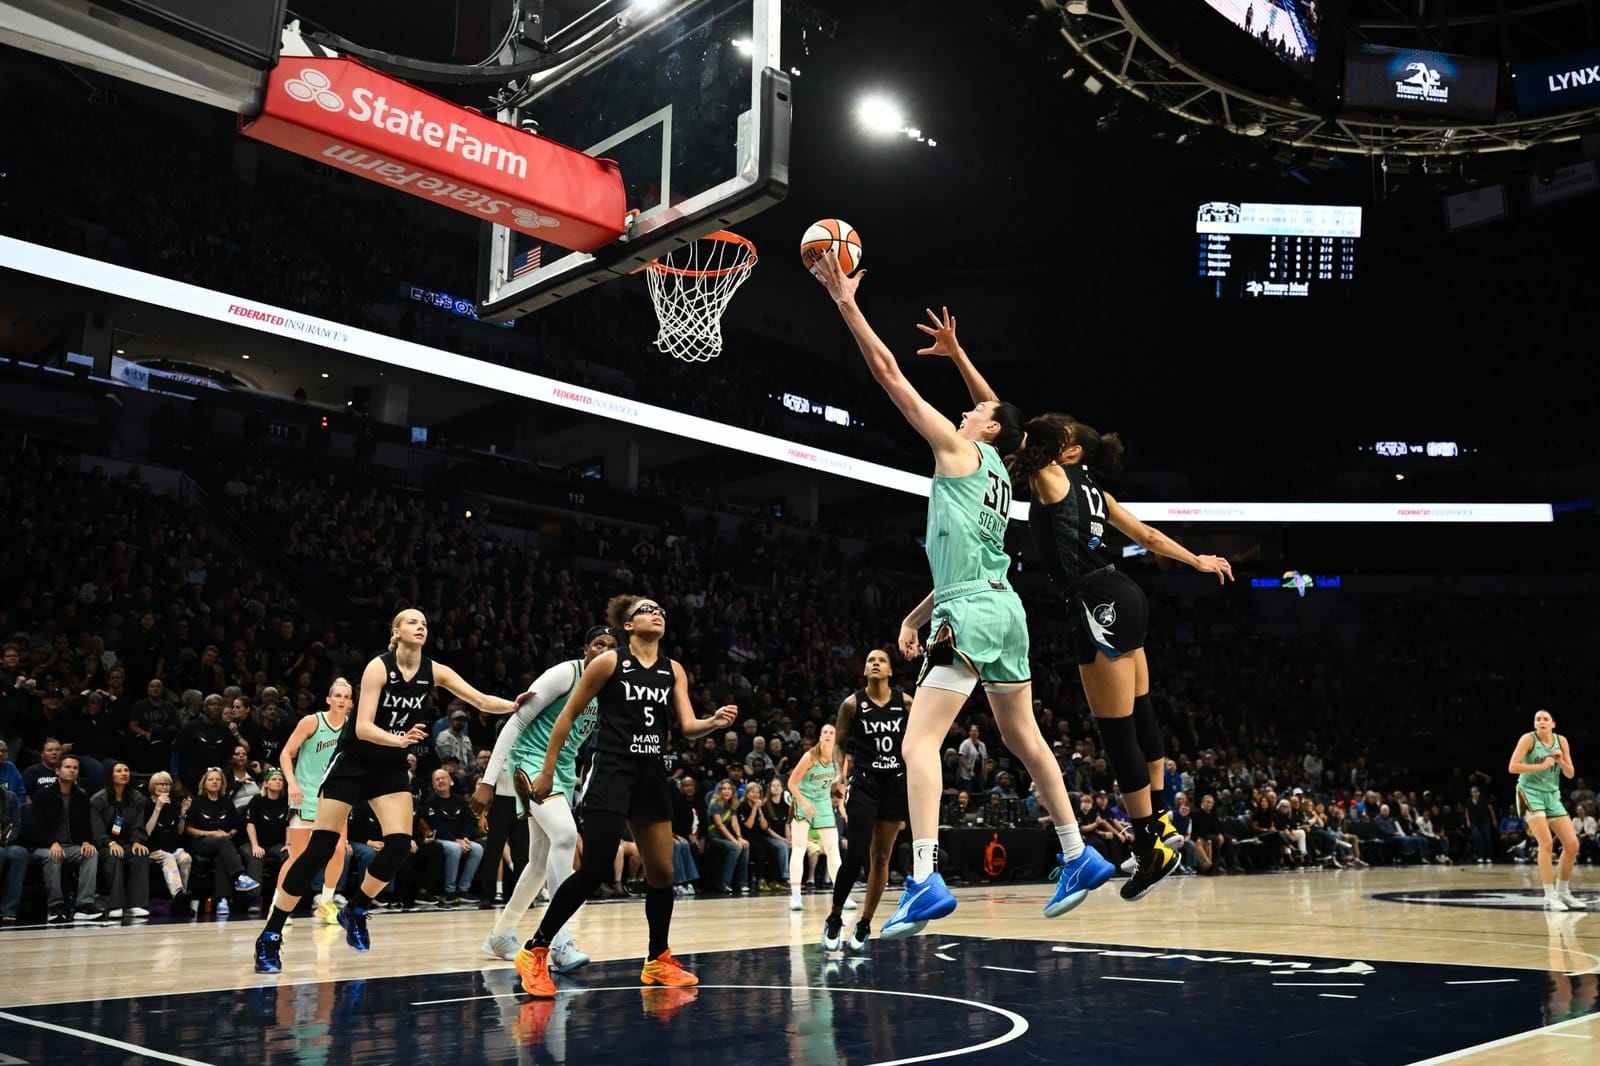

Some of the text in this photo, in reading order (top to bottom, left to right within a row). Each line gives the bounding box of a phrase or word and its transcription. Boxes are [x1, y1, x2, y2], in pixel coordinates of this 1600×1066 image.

[1549, 65, 1600, 92] LYNX
[228, 304, 343, 341] FEDERATED INSURANCE
[552, 388, 592, 405] FEDERATED
[568, 492, 585, 504] 112
[983, 470, 1010, 521] 30
[1081, 484, 1106, 520] 12
[383, 689, 428, 710] LYNX
[620, 680, 671, 705] LYNX
[389, 711, 410, 727] 14
[643, 706, 655, 727] 5
[860, 717, 903, 735] LYNX
[633, 734, 660, 744] MAYO
[874, 736, 893, 753] 10
[629, 744, 661, 754] CLINIC
[872, 761, 901, 769] CLINIC
